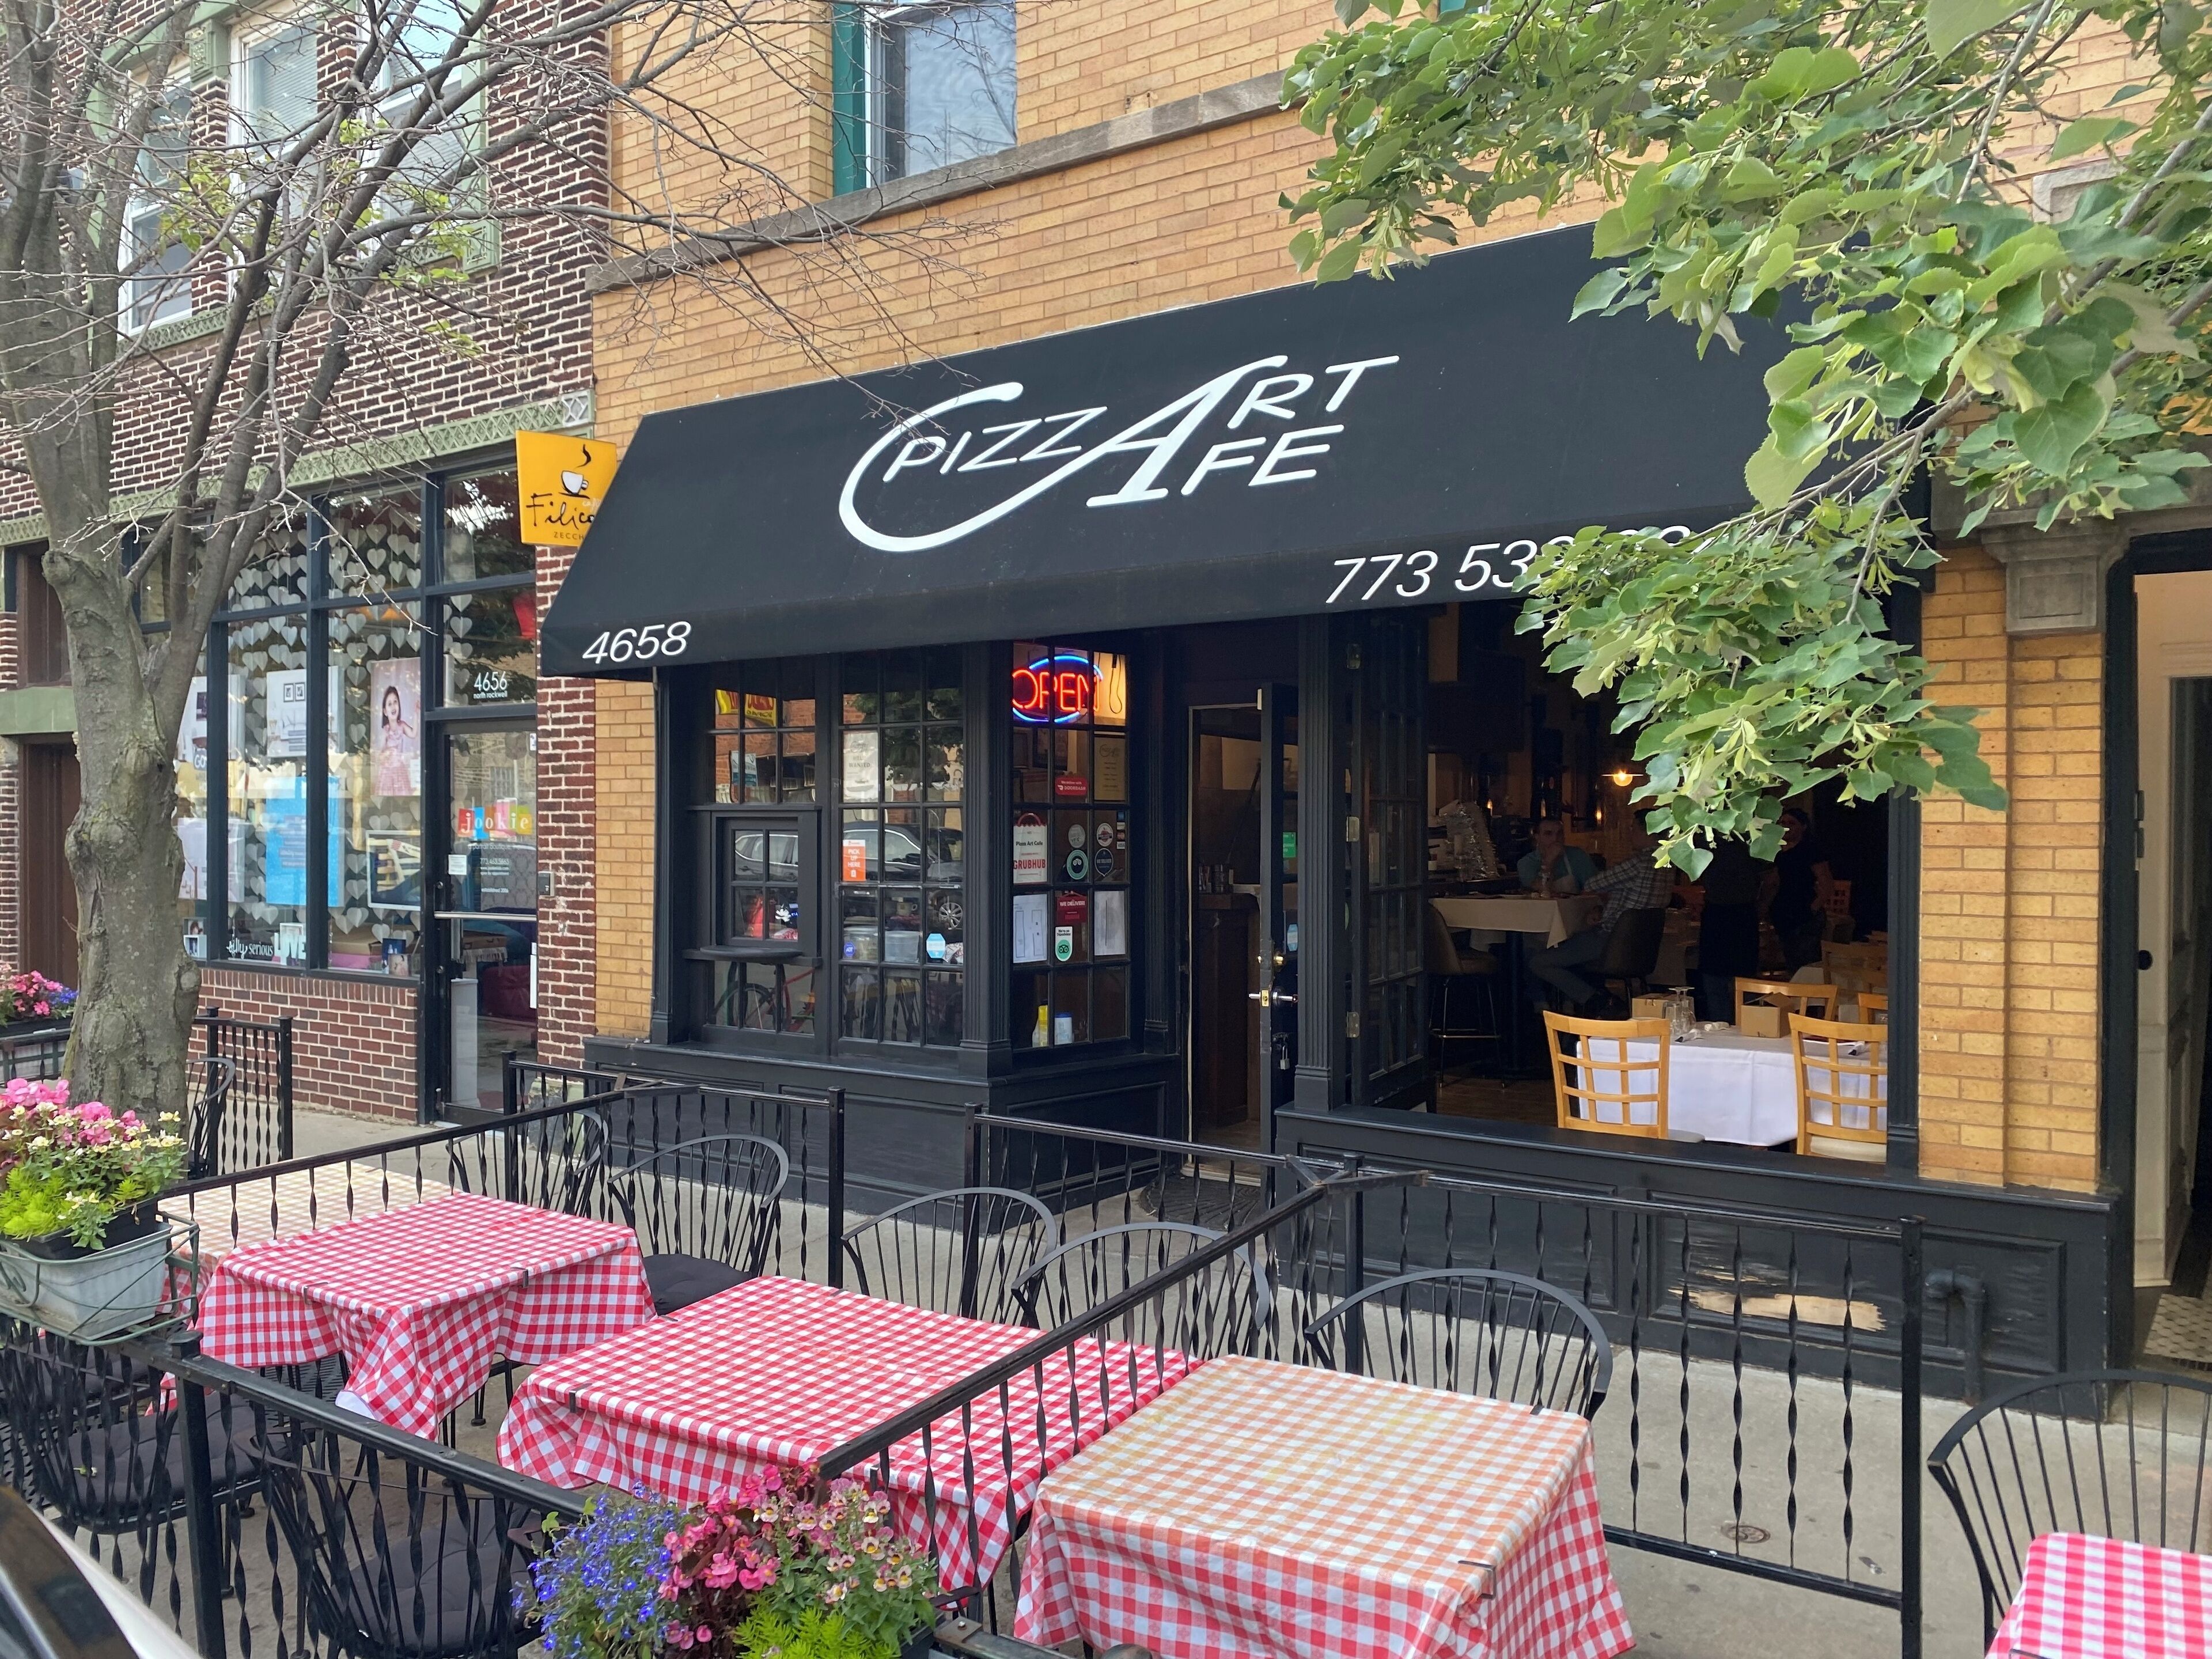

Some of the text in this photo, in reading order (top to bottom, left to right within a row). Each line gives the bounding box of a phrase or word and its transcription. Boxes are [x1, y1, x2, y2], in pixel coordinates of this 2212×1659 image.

[1325, 550, 1438, 604] 773
[582, 621, 691, 664] 4658
[474, 671, 507, 691] 4656
[1012, 669, 1101, 712] OPEN
[486, 690, 507, 698] rockwell
[461, 812, 529, 834] jookie
[1013, 859, 1046, 869] GRUBHUB
[249, 941, 273, 957] serious
